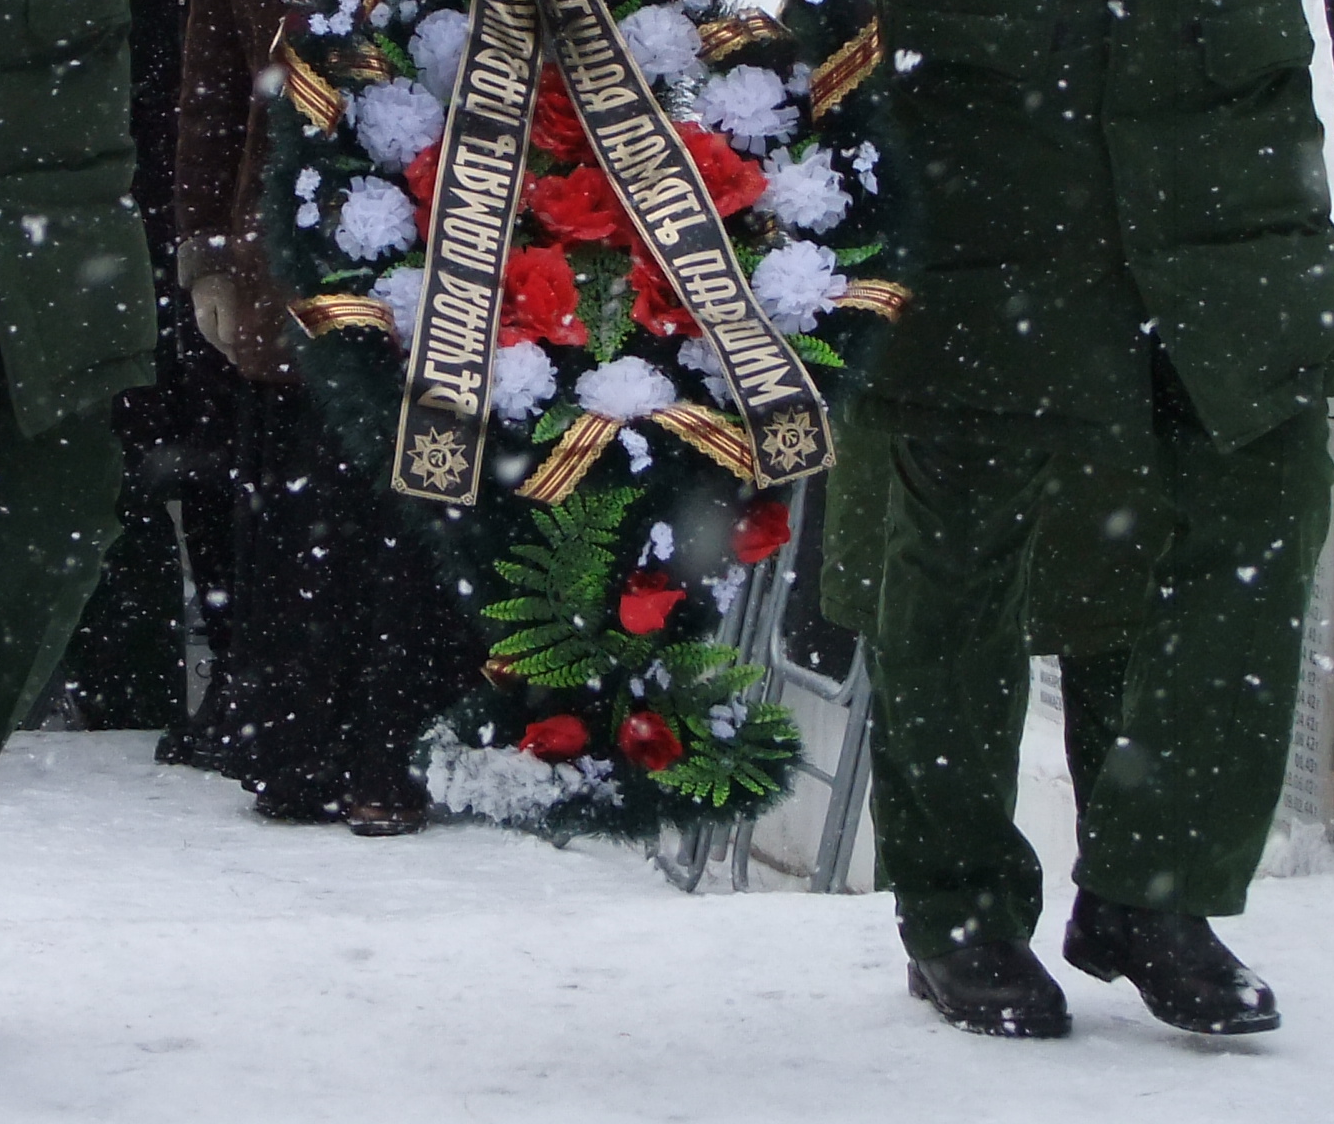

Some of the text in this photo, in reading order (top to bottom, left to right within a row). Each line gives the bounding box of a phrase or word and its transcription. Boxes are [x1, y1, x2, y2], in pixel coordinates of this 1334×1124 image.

[441, 133, 518, 273] ПАМЯТЬ
[595, 119, 704, 245] ПАМЯТЬ
[673, 250, 801, 406] ПАВШИМ
[416, 269, 494, 415] ВЕЧНАЯ
